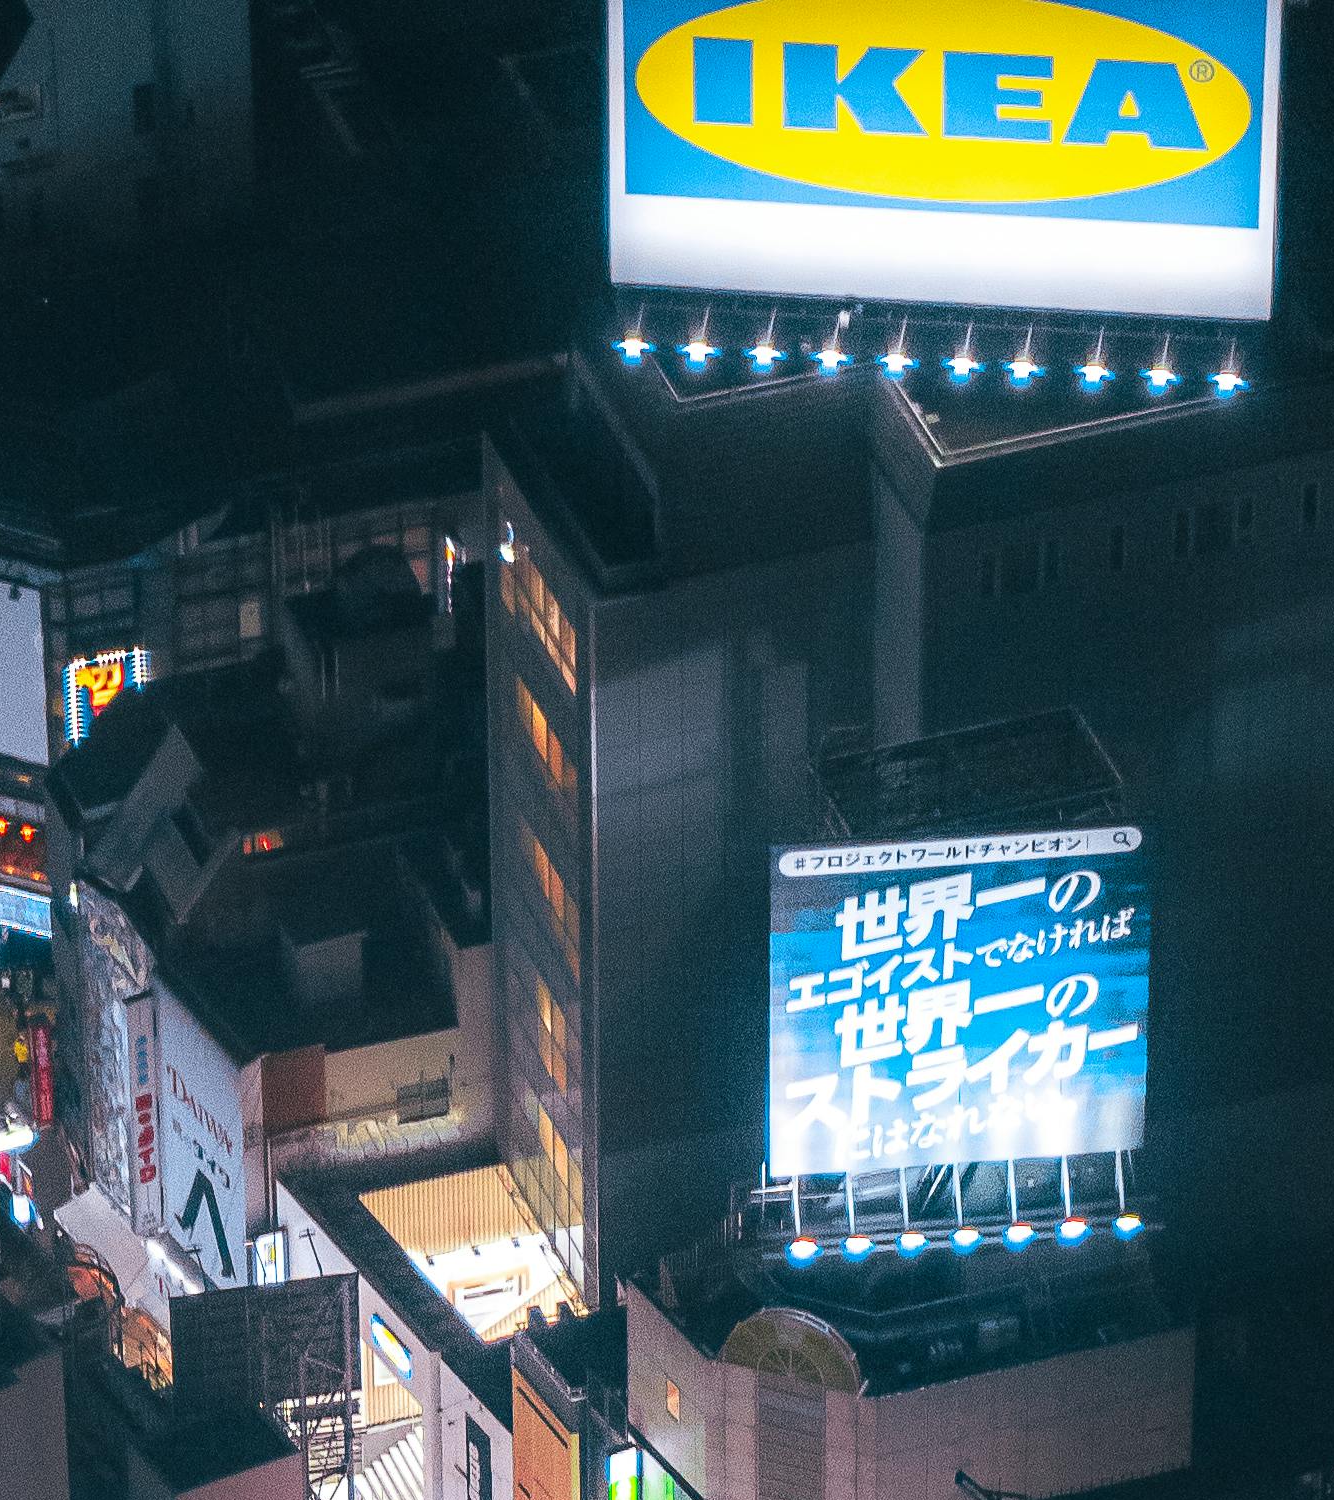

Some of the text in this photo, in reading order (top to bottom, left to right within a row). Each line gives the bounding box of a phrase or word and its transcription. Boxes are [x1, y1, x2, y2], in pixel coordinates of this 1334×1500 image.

[693, 36, 1208, 151] IKEA
[786, 908, 1136, 1014] エゴイストでなければ
[835, 870, 1102, 963] 世界一の
[834, 973, 1100, 1069] 世界一の
[785, 1022, 1139, 1130] ストライカー
